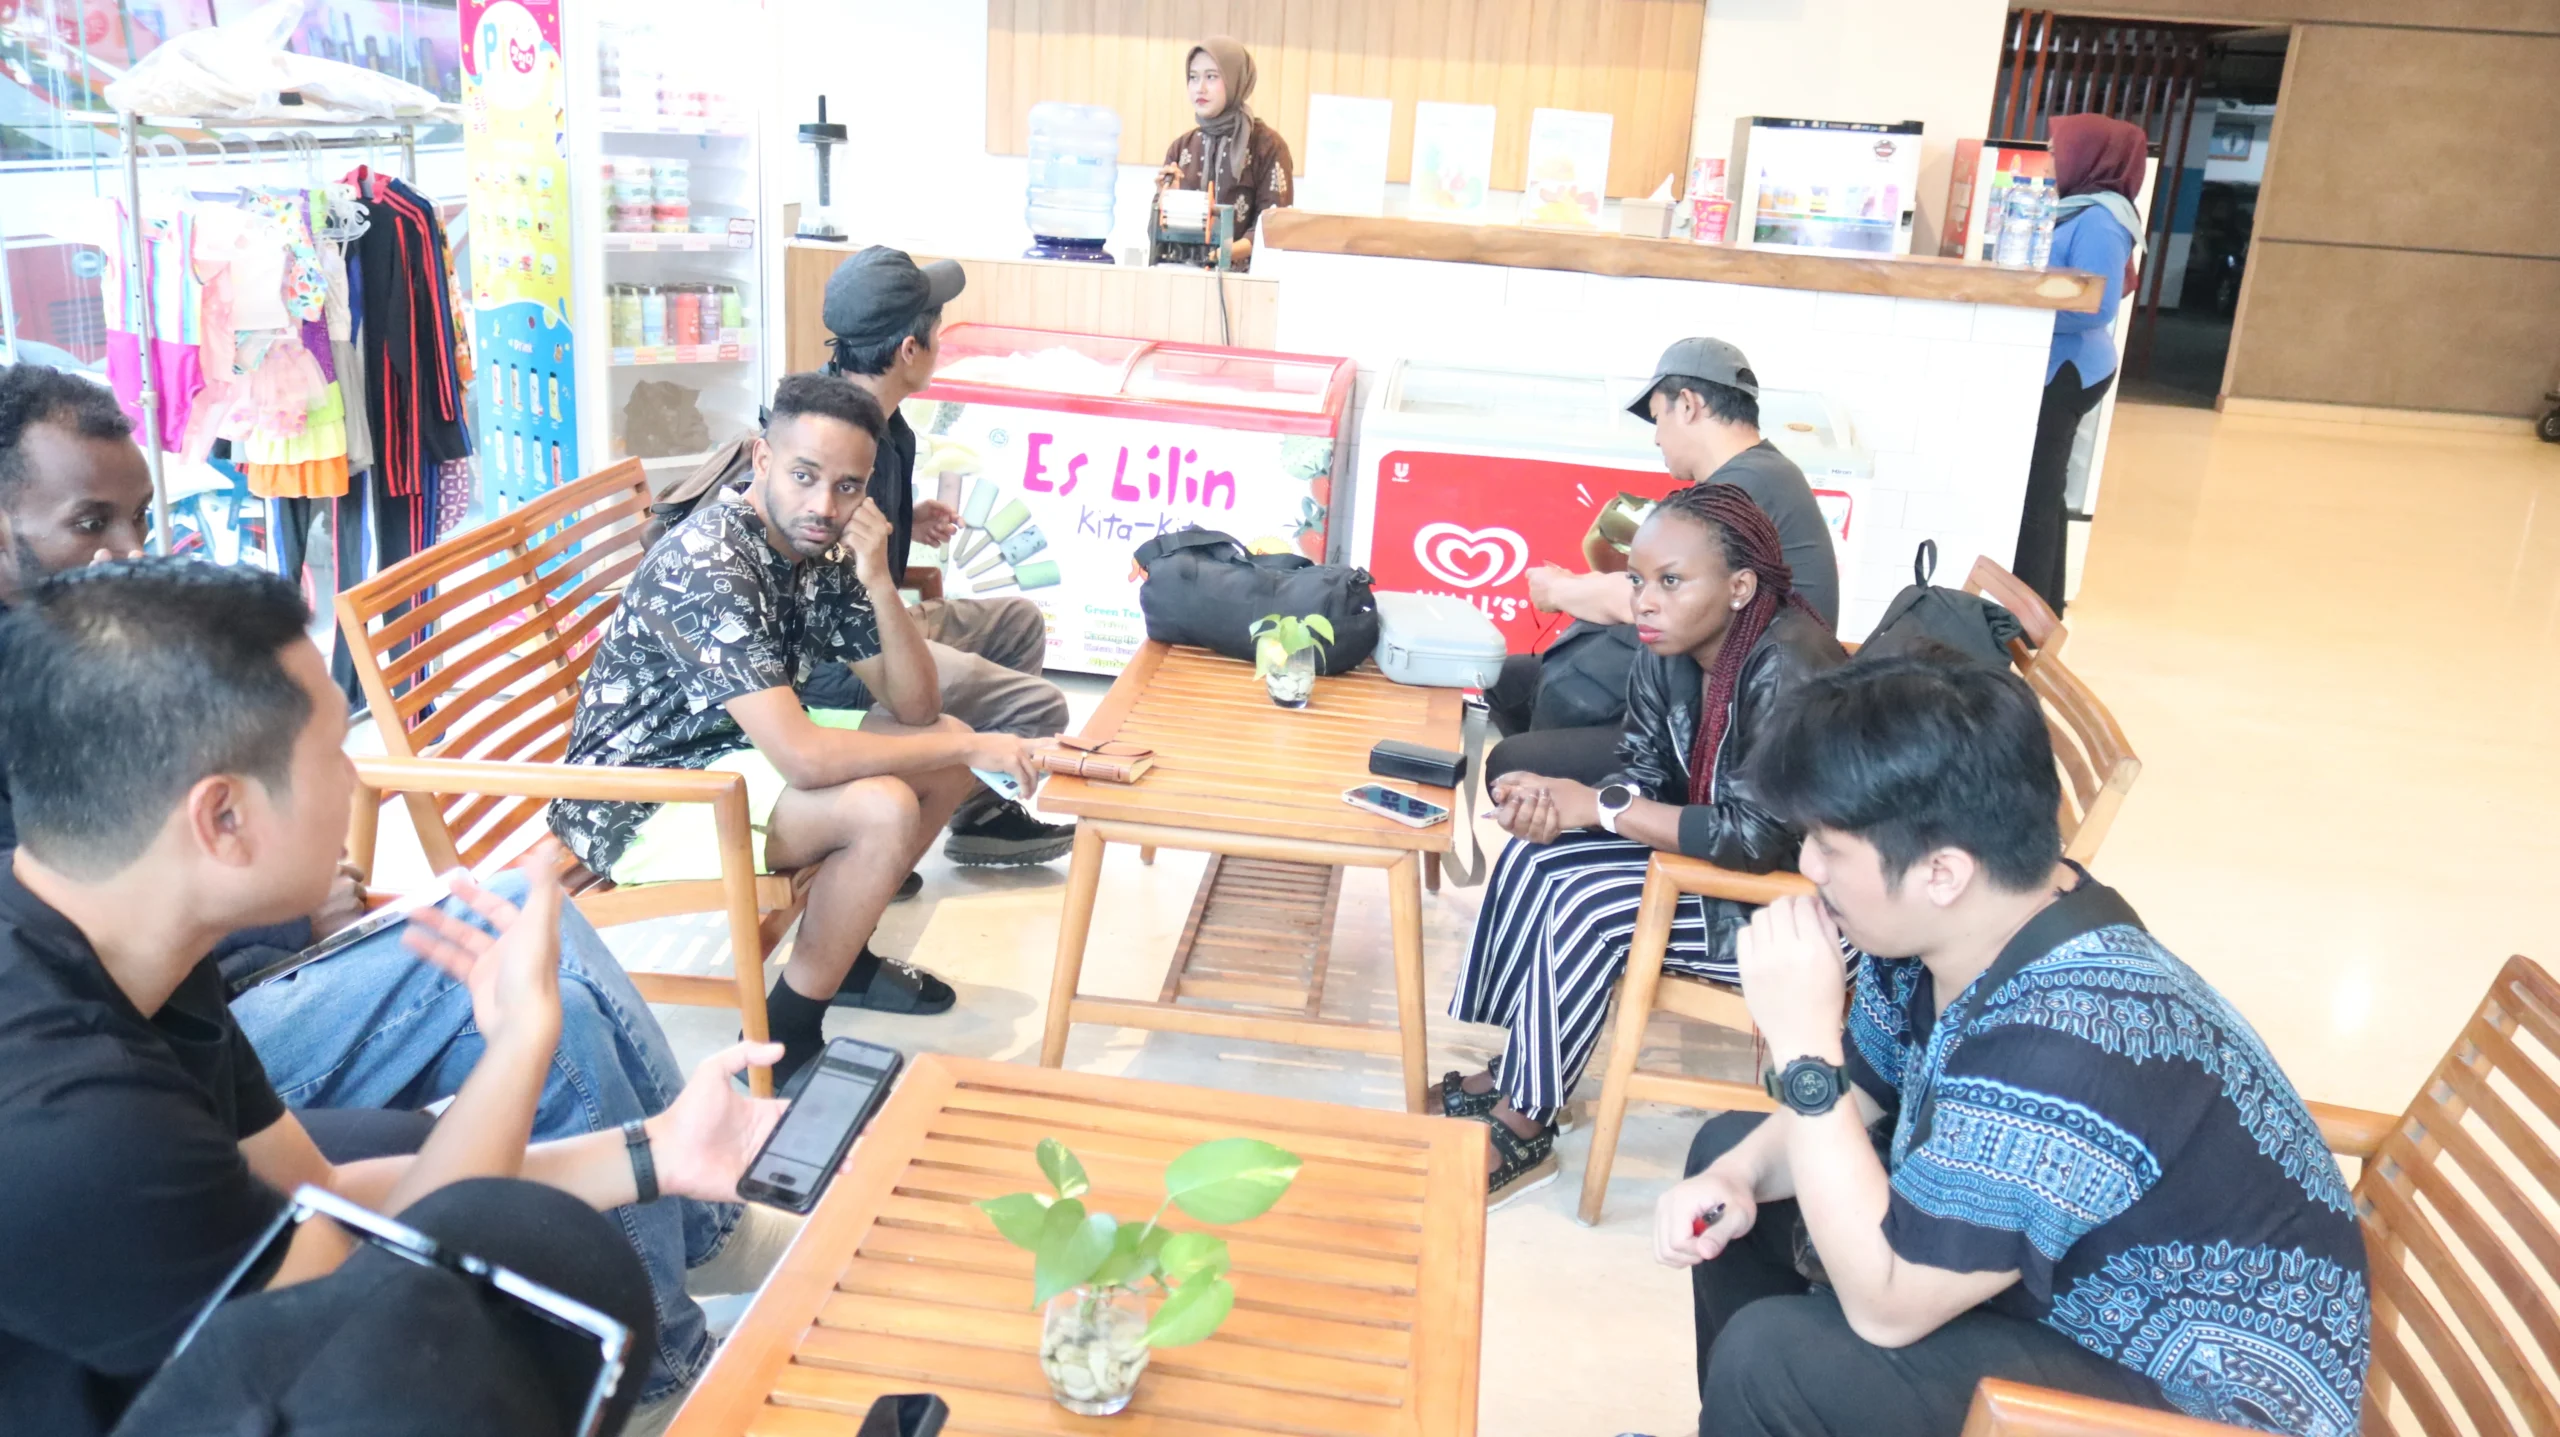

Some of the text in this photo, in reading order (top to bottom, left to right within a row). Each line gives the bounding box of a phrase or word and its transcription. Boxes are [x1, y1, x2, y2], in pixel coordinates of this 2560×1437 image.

[1023, 432, 1236, 510] Es Lilin
[1085, 604, 1141, 619] Green Tea
